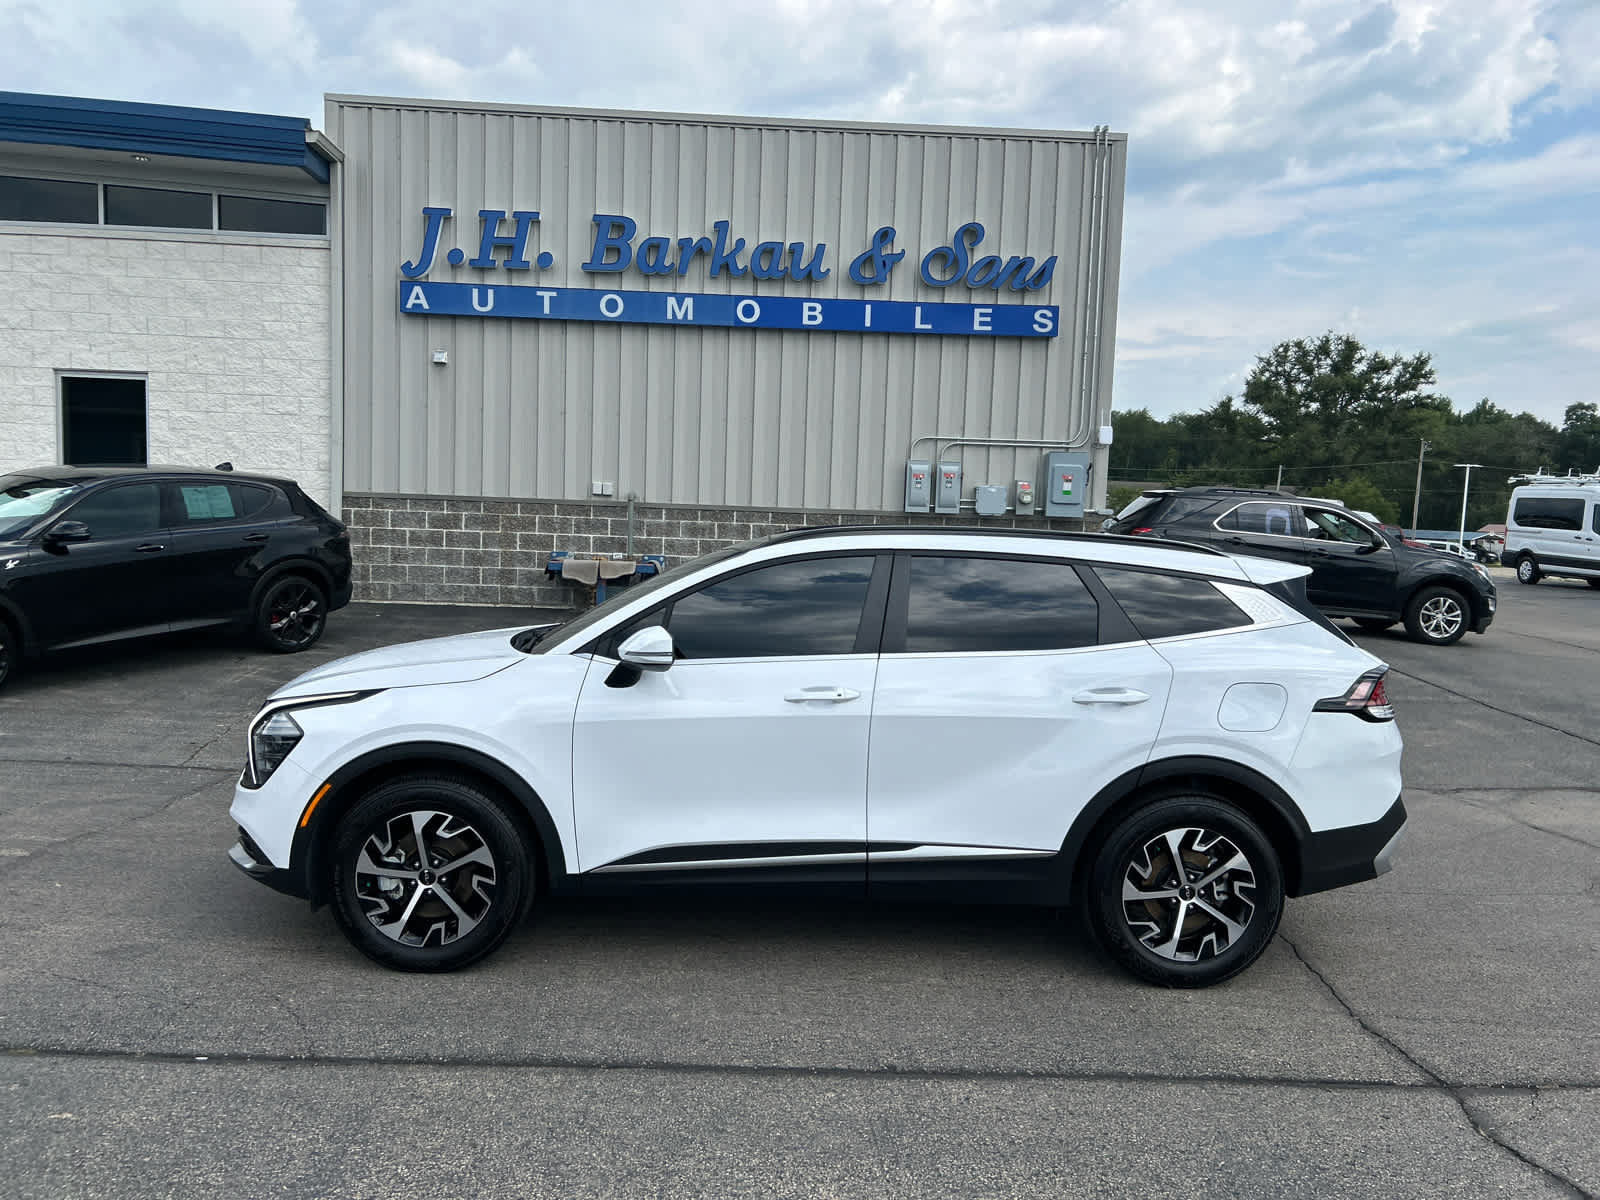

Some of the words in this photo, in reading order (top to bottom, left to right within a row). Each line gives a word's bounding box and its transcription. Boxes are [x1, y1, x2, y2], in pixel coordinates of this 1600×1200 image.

[400, 207, 554, 278] J.H.
[581, 214, 830, 281] Barkau
[849, 226, 906, 285] &
[921, 222, 1058, 290] Sons
[405, 285, 1055, 333] AUTOMOBILES
